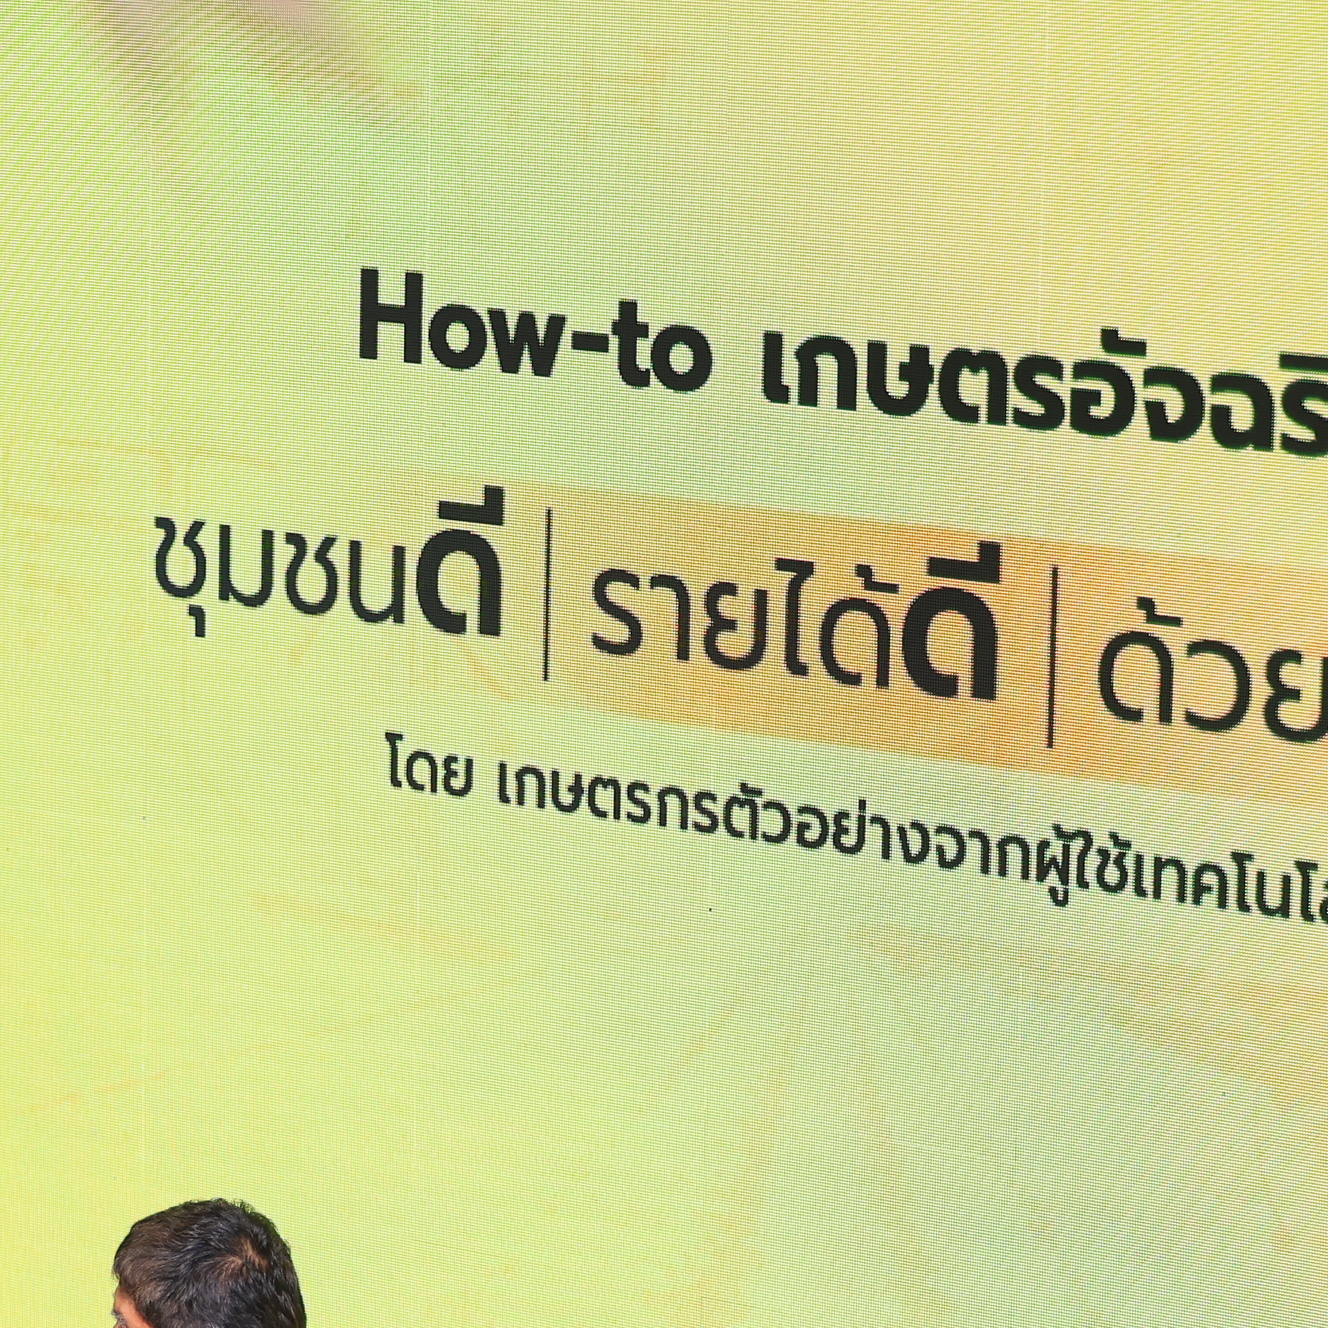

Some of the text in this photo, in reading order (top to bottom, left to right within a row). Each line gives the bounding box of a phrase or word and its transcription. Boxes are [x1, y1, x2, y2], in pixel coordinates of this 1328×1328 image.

[358, 266, 713, 393] How-to
[154, 485, 505, 638] ชุมชนดี
[590, 540, 1002, 703] รายได้ดี
[385, 732, 1328, 923] โดย เกษตรกรตัวอย่างจากผู้ใช้เทคโนโ
